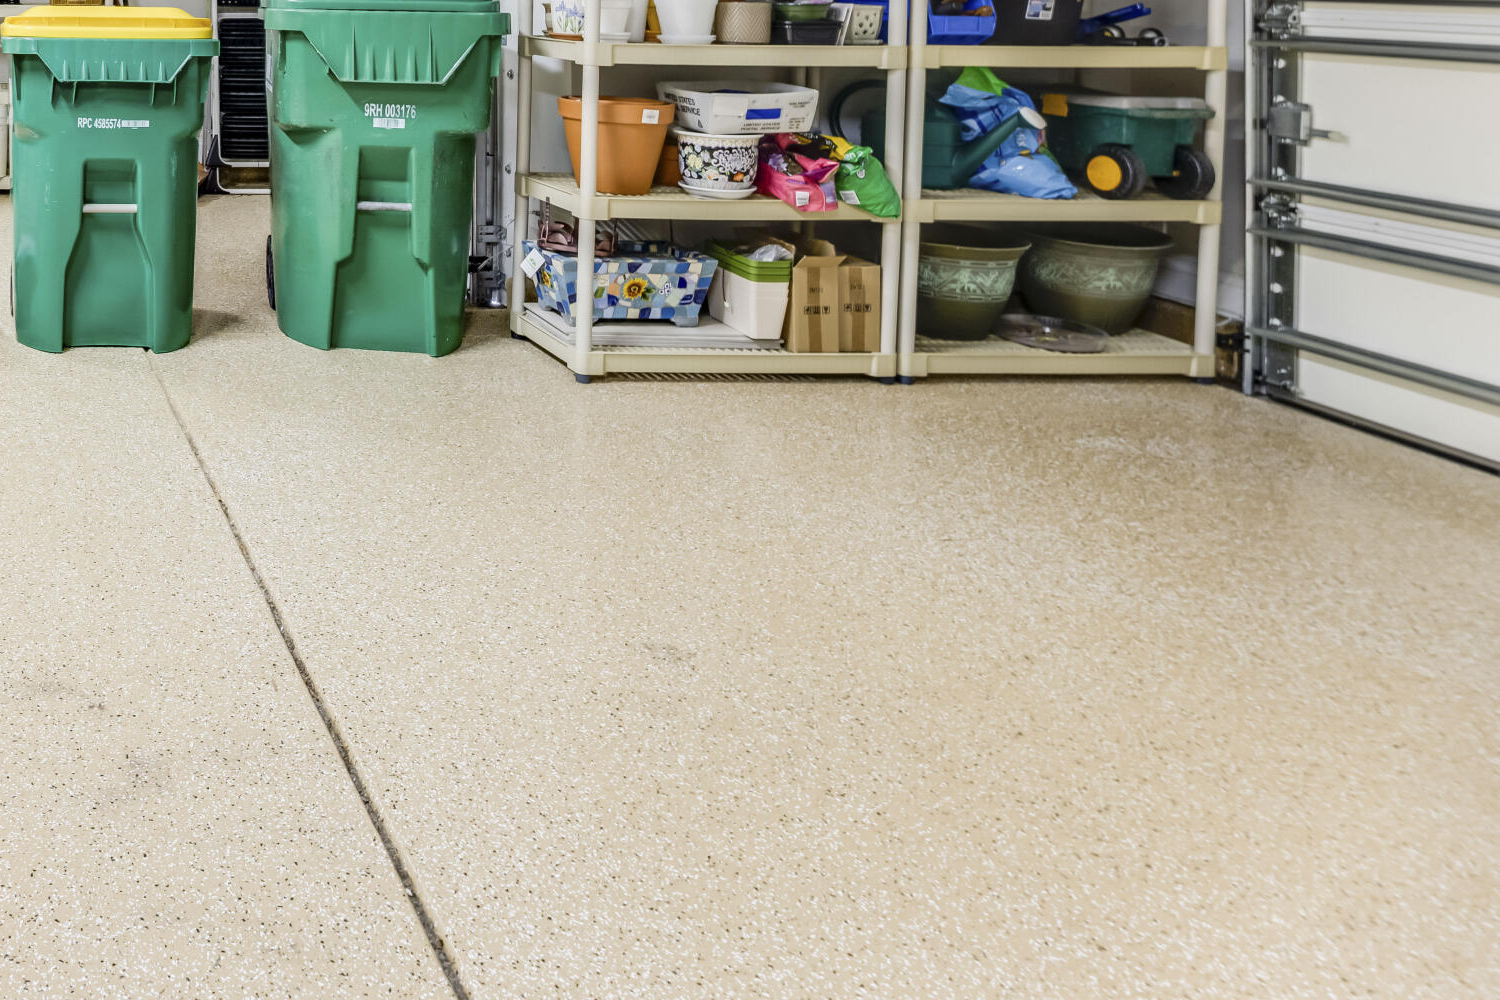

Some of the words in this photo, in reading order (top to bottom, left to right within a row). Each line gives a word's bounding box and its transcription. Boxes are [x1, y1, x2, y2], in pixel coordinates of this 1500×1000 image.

[364, 103, 383, 117] 9RH
[385, 104, 417, 119] 003176
[77, 117, 93, 128] RPC
